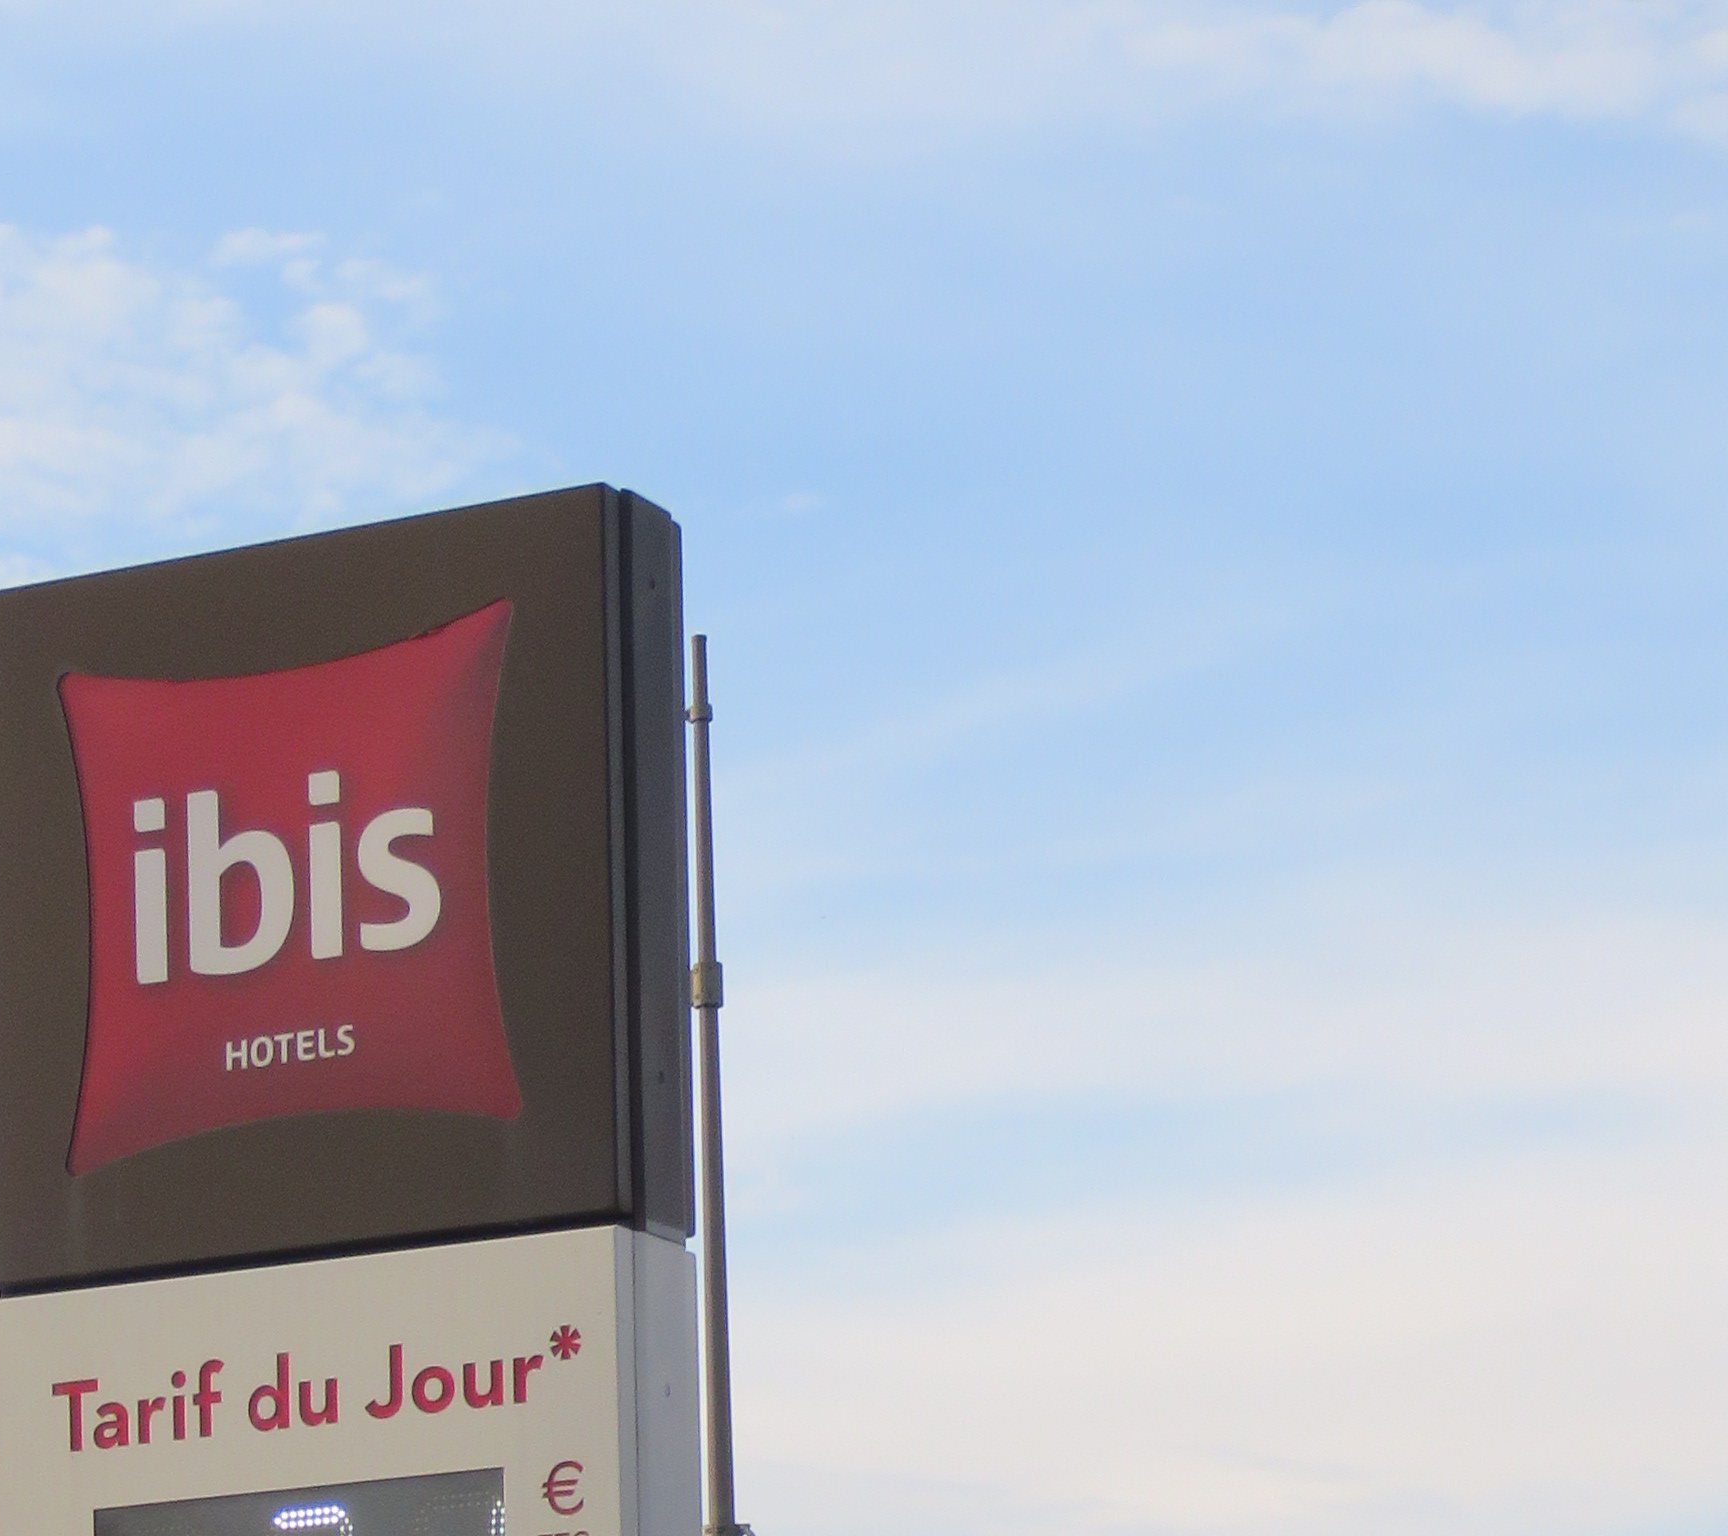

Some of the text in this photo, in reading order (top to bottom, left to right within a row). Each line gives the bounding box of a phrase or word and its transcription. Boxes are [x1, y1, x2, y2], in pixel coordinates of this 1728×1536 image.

[133, 770, 442, 985] ibis
[225, 1025, 355, 1071] HOTELS
[51, 1358, 225, 1453] Tarif
[248, 1351, 340, 1433] du
[541, 1460, 585, 1516] €
